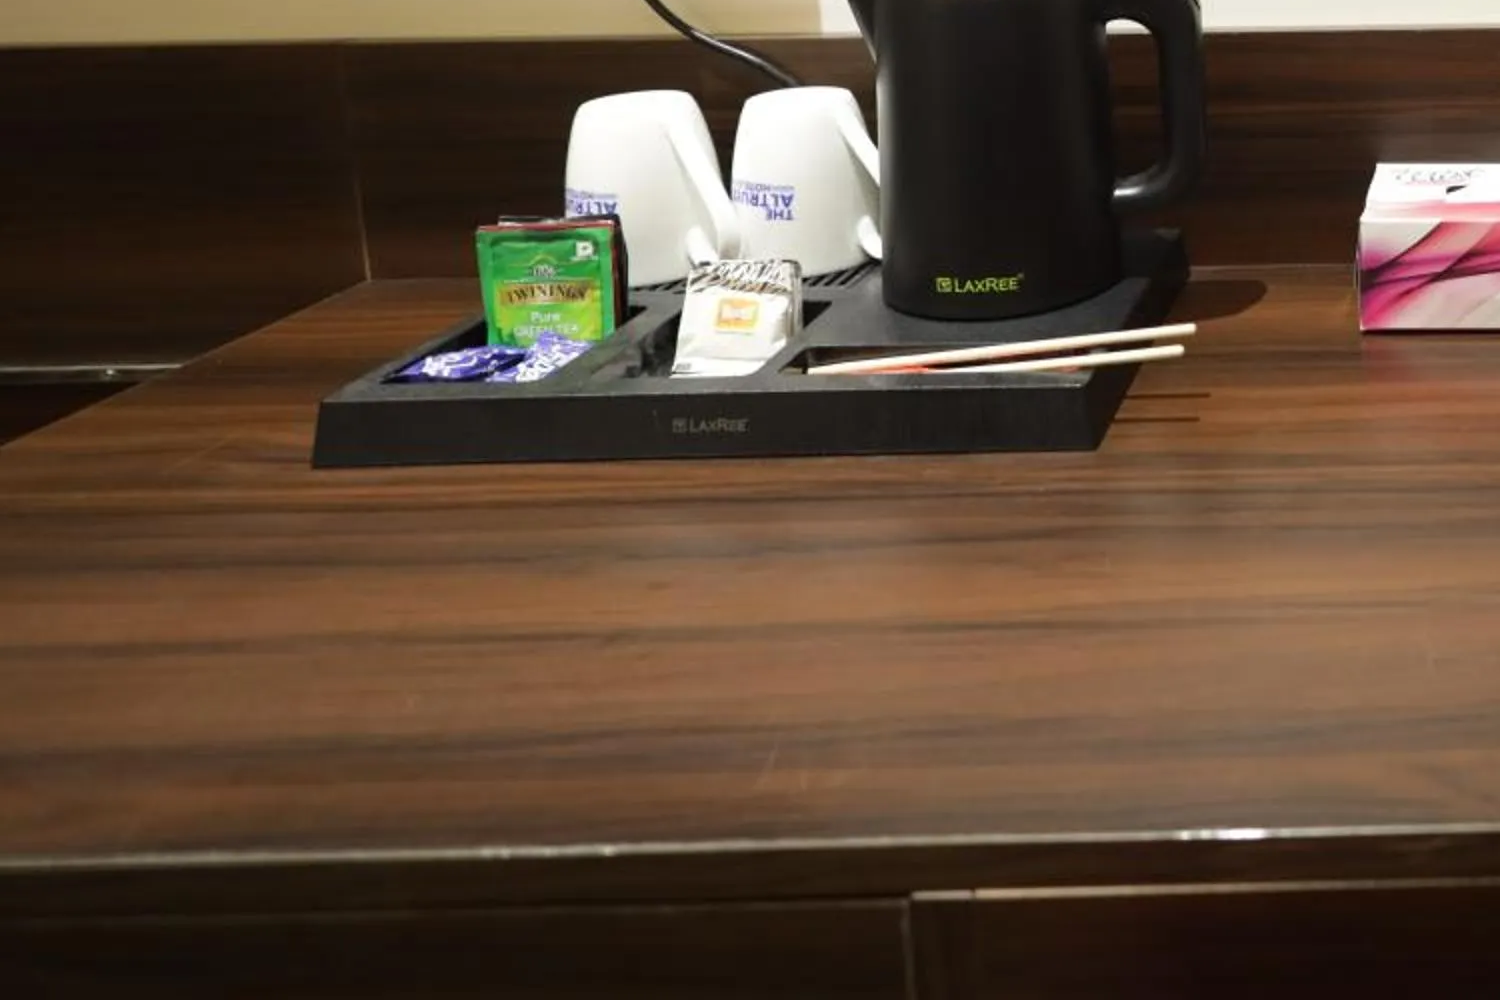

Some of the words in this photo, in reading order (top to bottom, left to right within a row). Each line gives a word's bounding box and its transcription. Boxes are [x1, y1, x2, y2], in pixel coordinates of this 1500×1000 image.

[766, 209, 794, 221] THE
[507, 282, 591, 304] TWININGS
[531, 311, 561, 324] Pure
